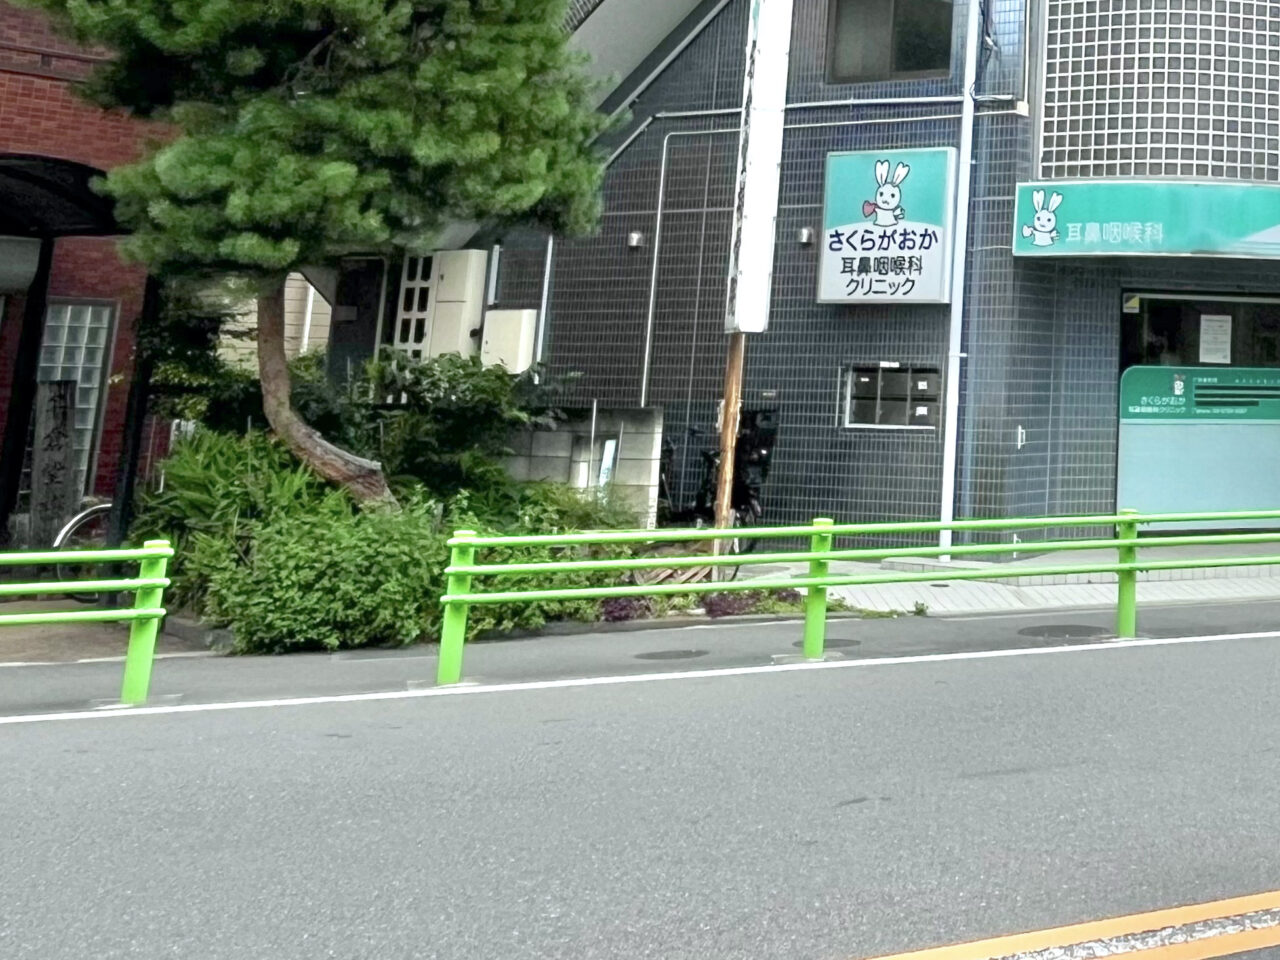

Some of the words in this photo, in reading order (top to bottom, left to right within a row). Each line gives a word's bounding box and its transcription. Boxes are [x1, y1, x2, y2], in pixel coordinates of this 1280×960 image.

[829, 228, 938, 252] さくらがおか
[1066, 222, 1163, 244] 耳鼻咽喉科
[840, 255, 923, 276] 耳鼻咽喉科
[846, 277, 916, 296] クリニック
